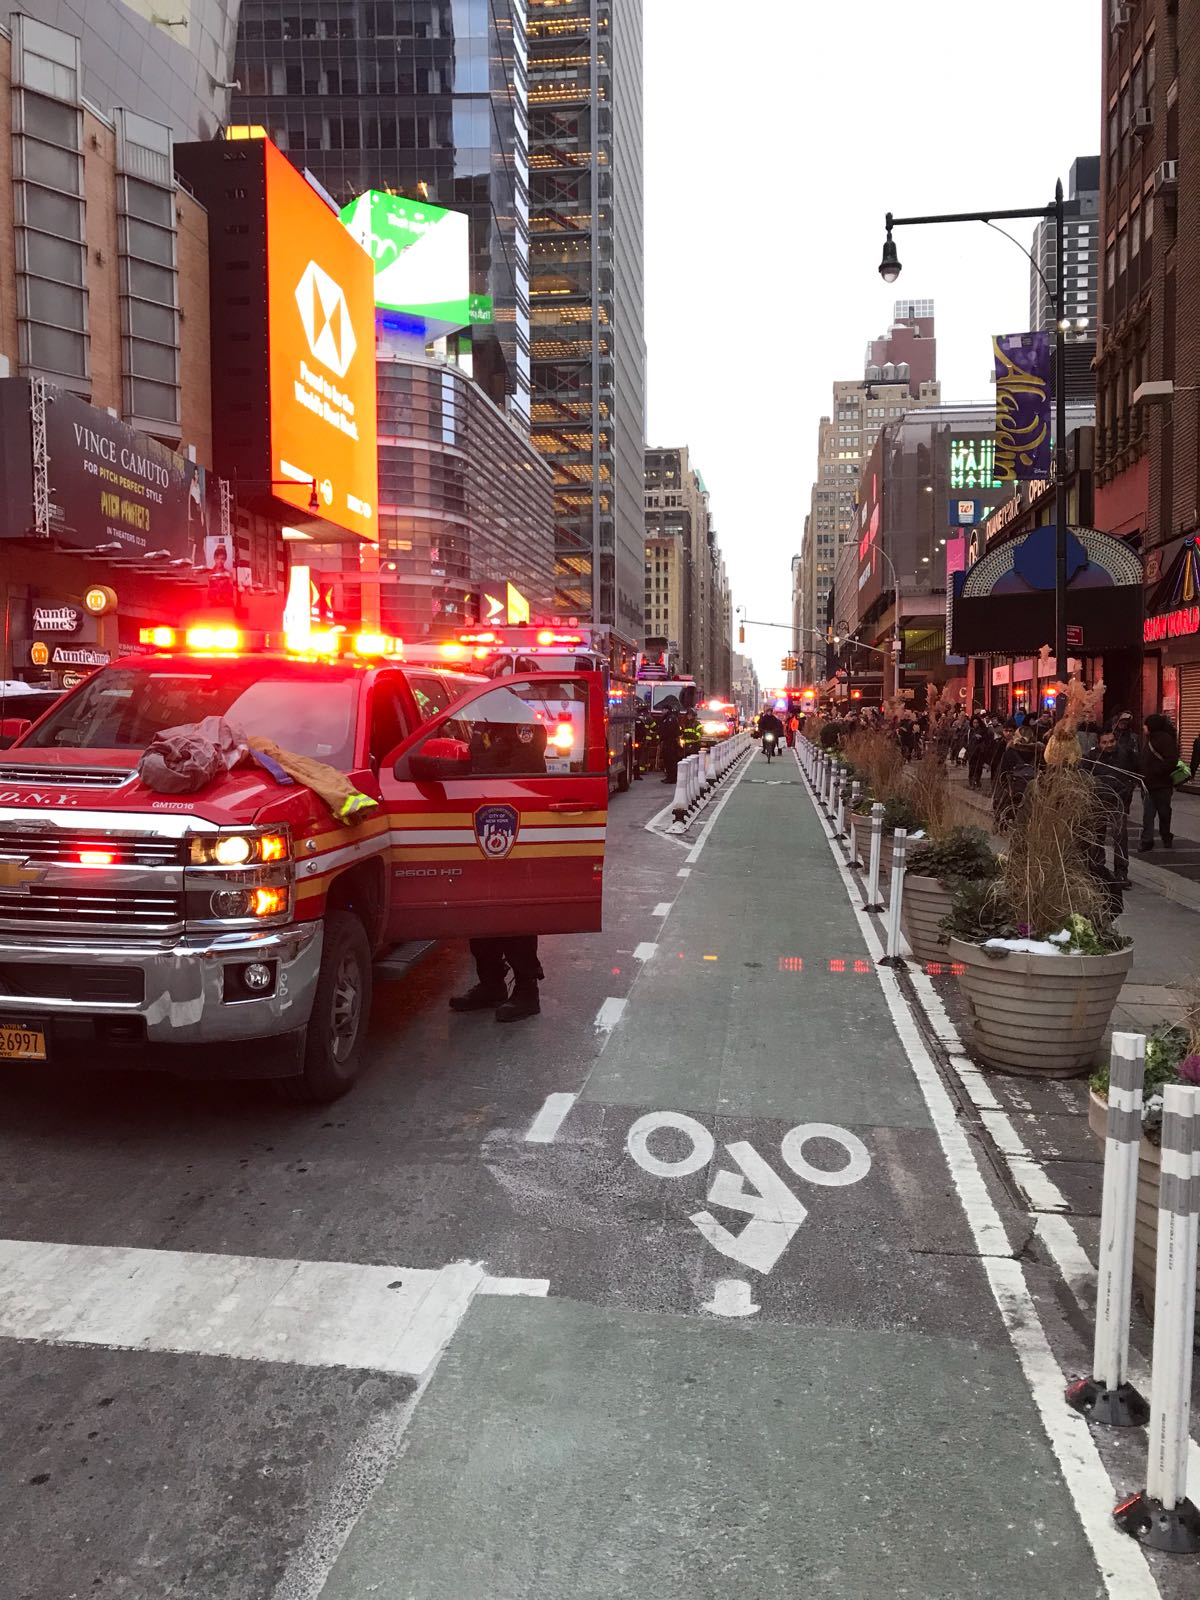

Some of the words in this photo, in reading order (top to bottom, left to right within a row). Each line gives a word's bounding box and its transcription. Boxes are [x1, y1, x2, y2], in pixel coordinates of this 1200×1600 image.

[73, 422, 117, 463] VINCE
[120, 448, 169, 488] CAMUTO
[83, 459, 98, 476] FOR
[99, 466, 119, 485] PITCH
[119, 475, 145, 497] PERFECT
[145, 487, 163, 504] STYLE
[33, 607, 77, 620] Auntie
[34, 619, 77, 631] Anne's
[152, 801, 195, 810] GM17016
[395, 868, 437, 878] 2500
[440, 867, 463, 877] HD
[7, 1031, 39, 1053] 6997
